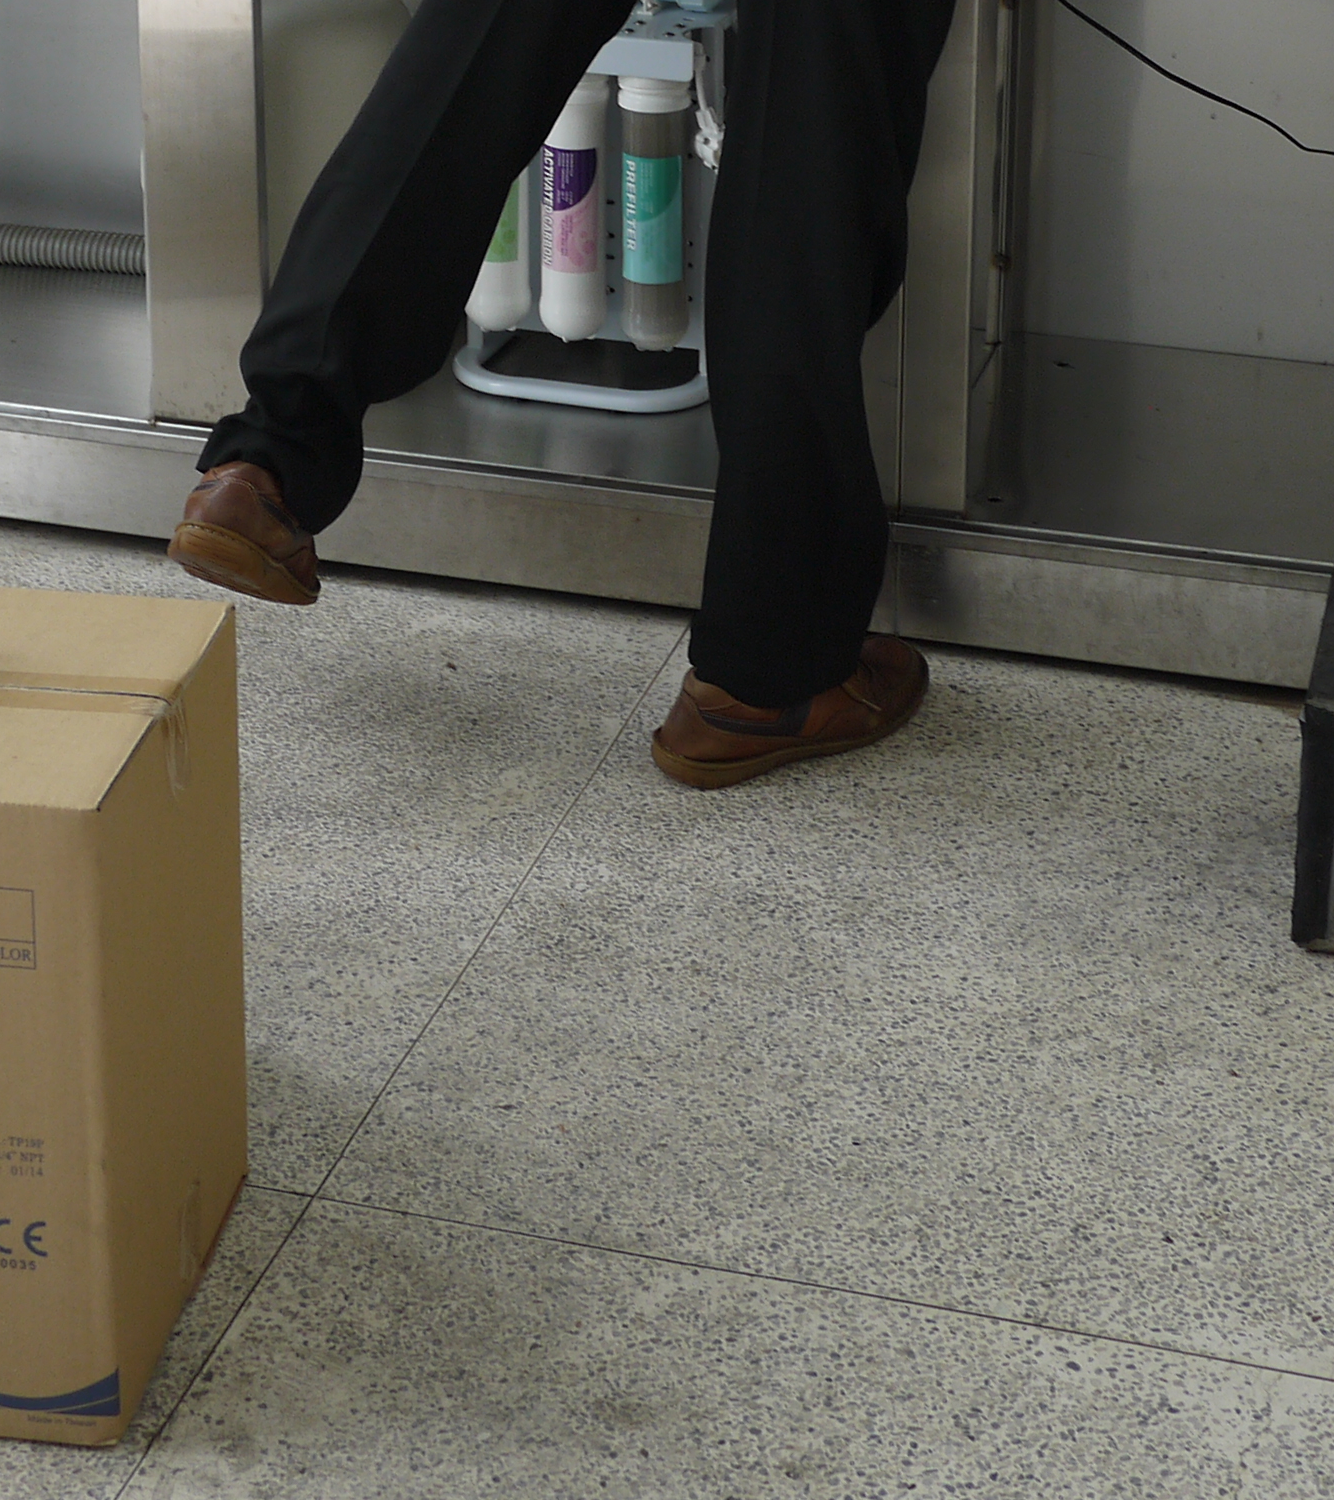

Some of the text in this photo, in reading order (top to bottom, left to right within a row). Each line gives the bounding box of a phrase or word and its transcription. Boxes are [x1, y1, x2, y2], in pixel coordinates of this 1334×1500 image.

[543, 148, 555, 266] ACTIVATED CARBON
[626, 159, 637, 252] PREFILTER
[19, 1151, 45, 1163] NPT
